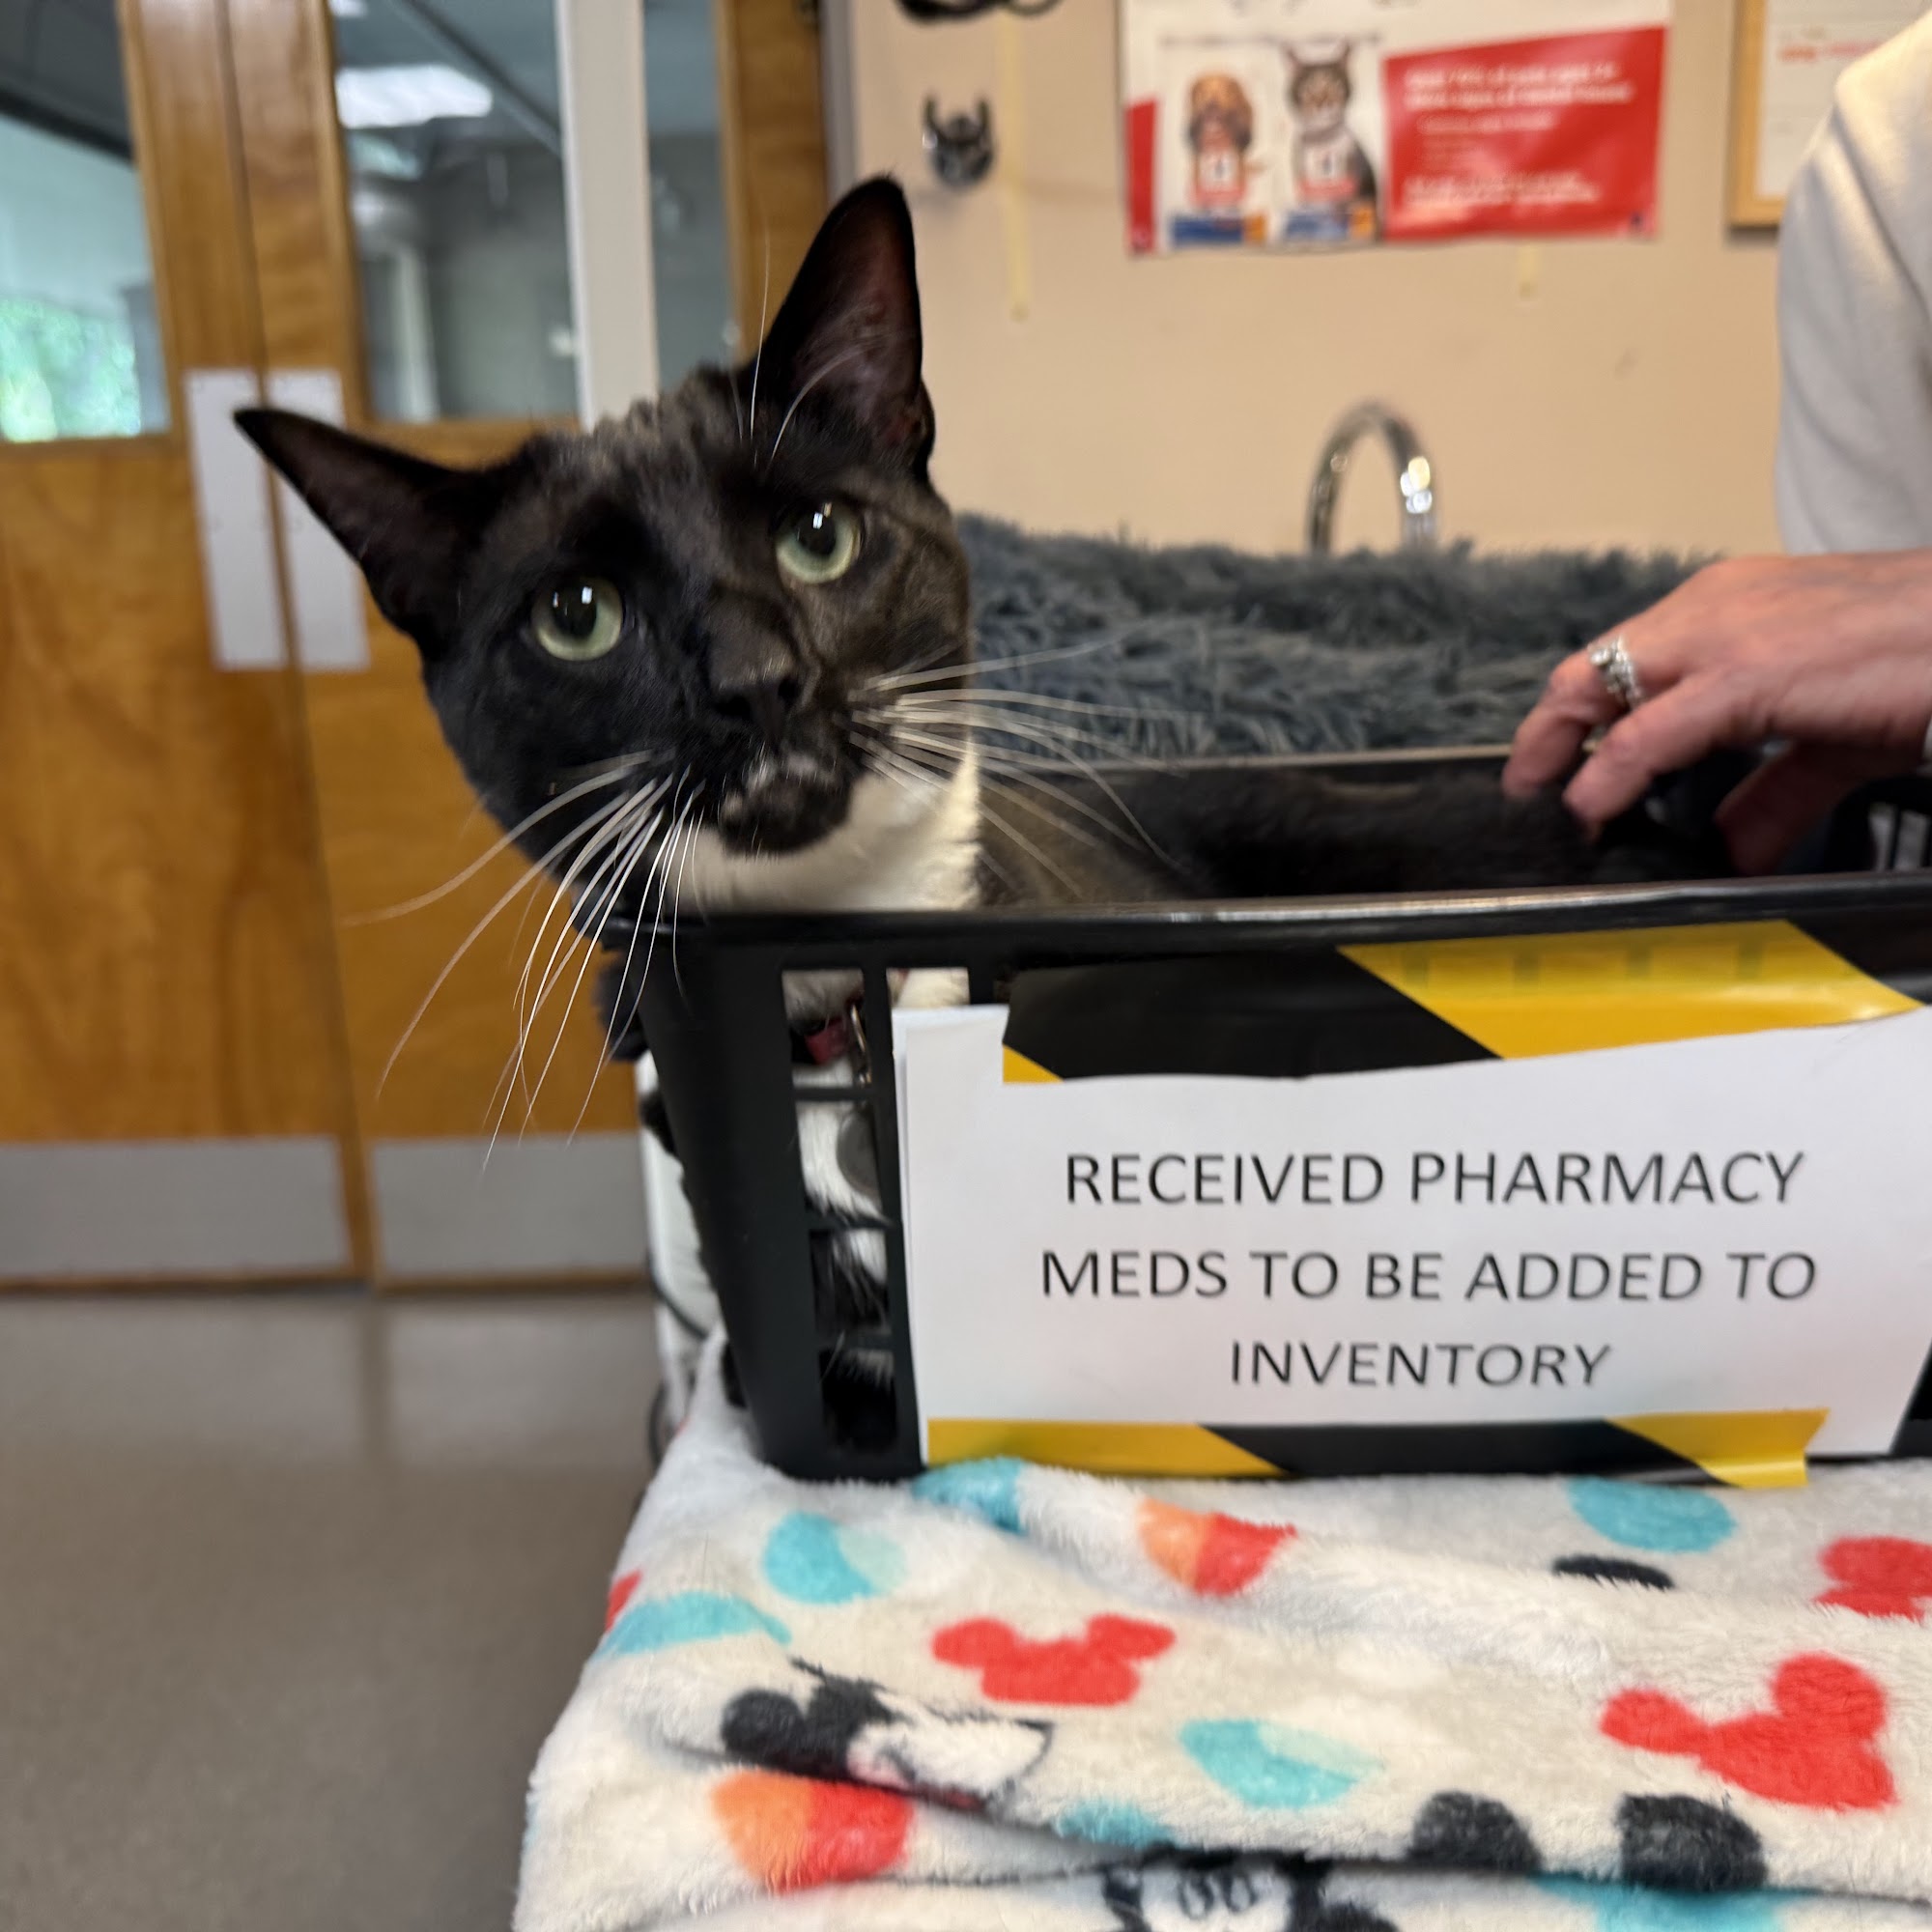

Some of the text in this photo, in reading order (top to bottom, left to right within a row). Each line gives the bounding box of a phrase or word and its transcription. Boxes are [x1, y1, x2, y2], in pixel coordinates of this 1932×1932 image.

[1066, 1151, 1804, 1205] RECEIVED PHARMACY
[1041, 1250, 1817, 1301] MEDS TO BE ADDED TO
[1231, 1341, 1611, 1387] INVENTORY
